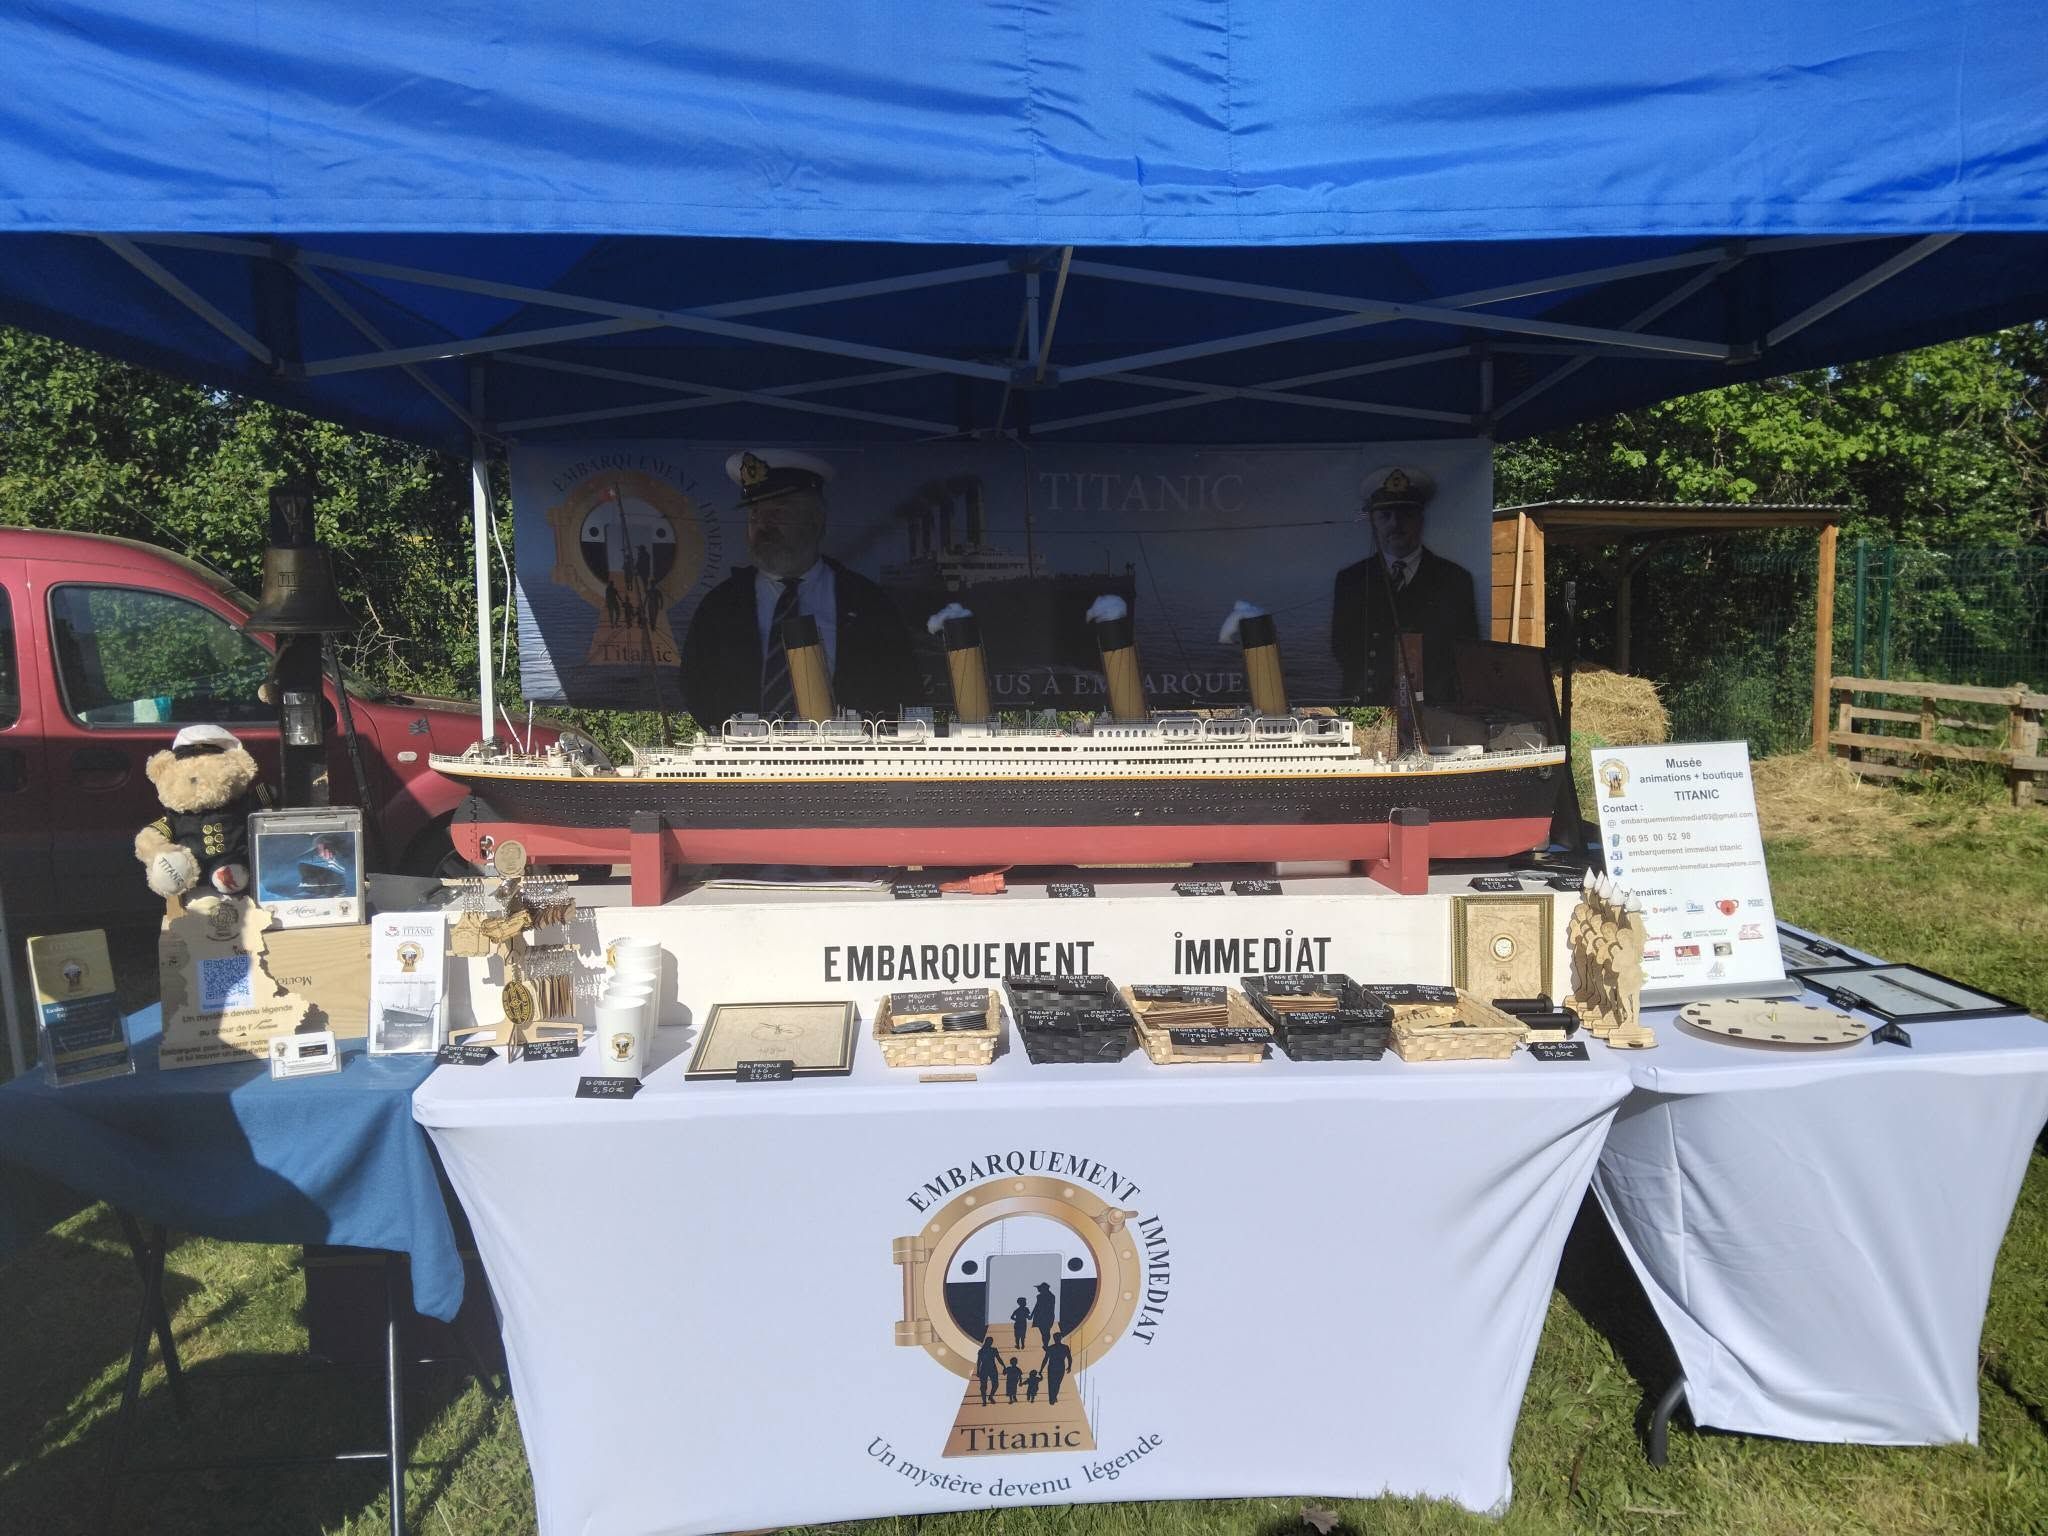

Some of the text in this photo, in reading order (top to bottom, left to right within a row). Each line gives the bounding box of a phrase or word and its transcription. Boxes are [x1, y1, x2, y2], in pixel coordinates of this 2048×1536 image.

[1039, 472, 1243, 513] TITANIC
[1042, 662, 1249, 698] À EMARQUE
[1666, 758, 1702, 769] Musée
[1640, 773, 1691, 784] animations
[1703, 770, 1744, 781] boutique
[1674, 789, 1720, 801] TITANIC
[1603, 803, 1638, 813] Contact
[1626, 835, 1637, 843] 06
[1638, 834, 1649, 843] 95
[1653, 834, 1663, 842] 00
[1668, 833, 1677, 841] 52
[1629, 848, 1683, 858] embarquement
[1685, 845, 1718, 853] immediat
[402, 928, 434, 937] TITANIC
[823, 940, 1095, 984] EMBARQUEMENT
[231, 1008, 260, 1018] devenu
[262, 1004, 293, 1015] légende
[592, 1086, 625, 1095] 2,50€
[906, 1149, 1141, 1214] EMBARQUEMENT
[1132, 1215, 1171, 1346] IMMEDIAT
[961, 1425, 1082, 1452] Titanic
[866, 1433, 1164, 1498] Un mystère devenu légende
